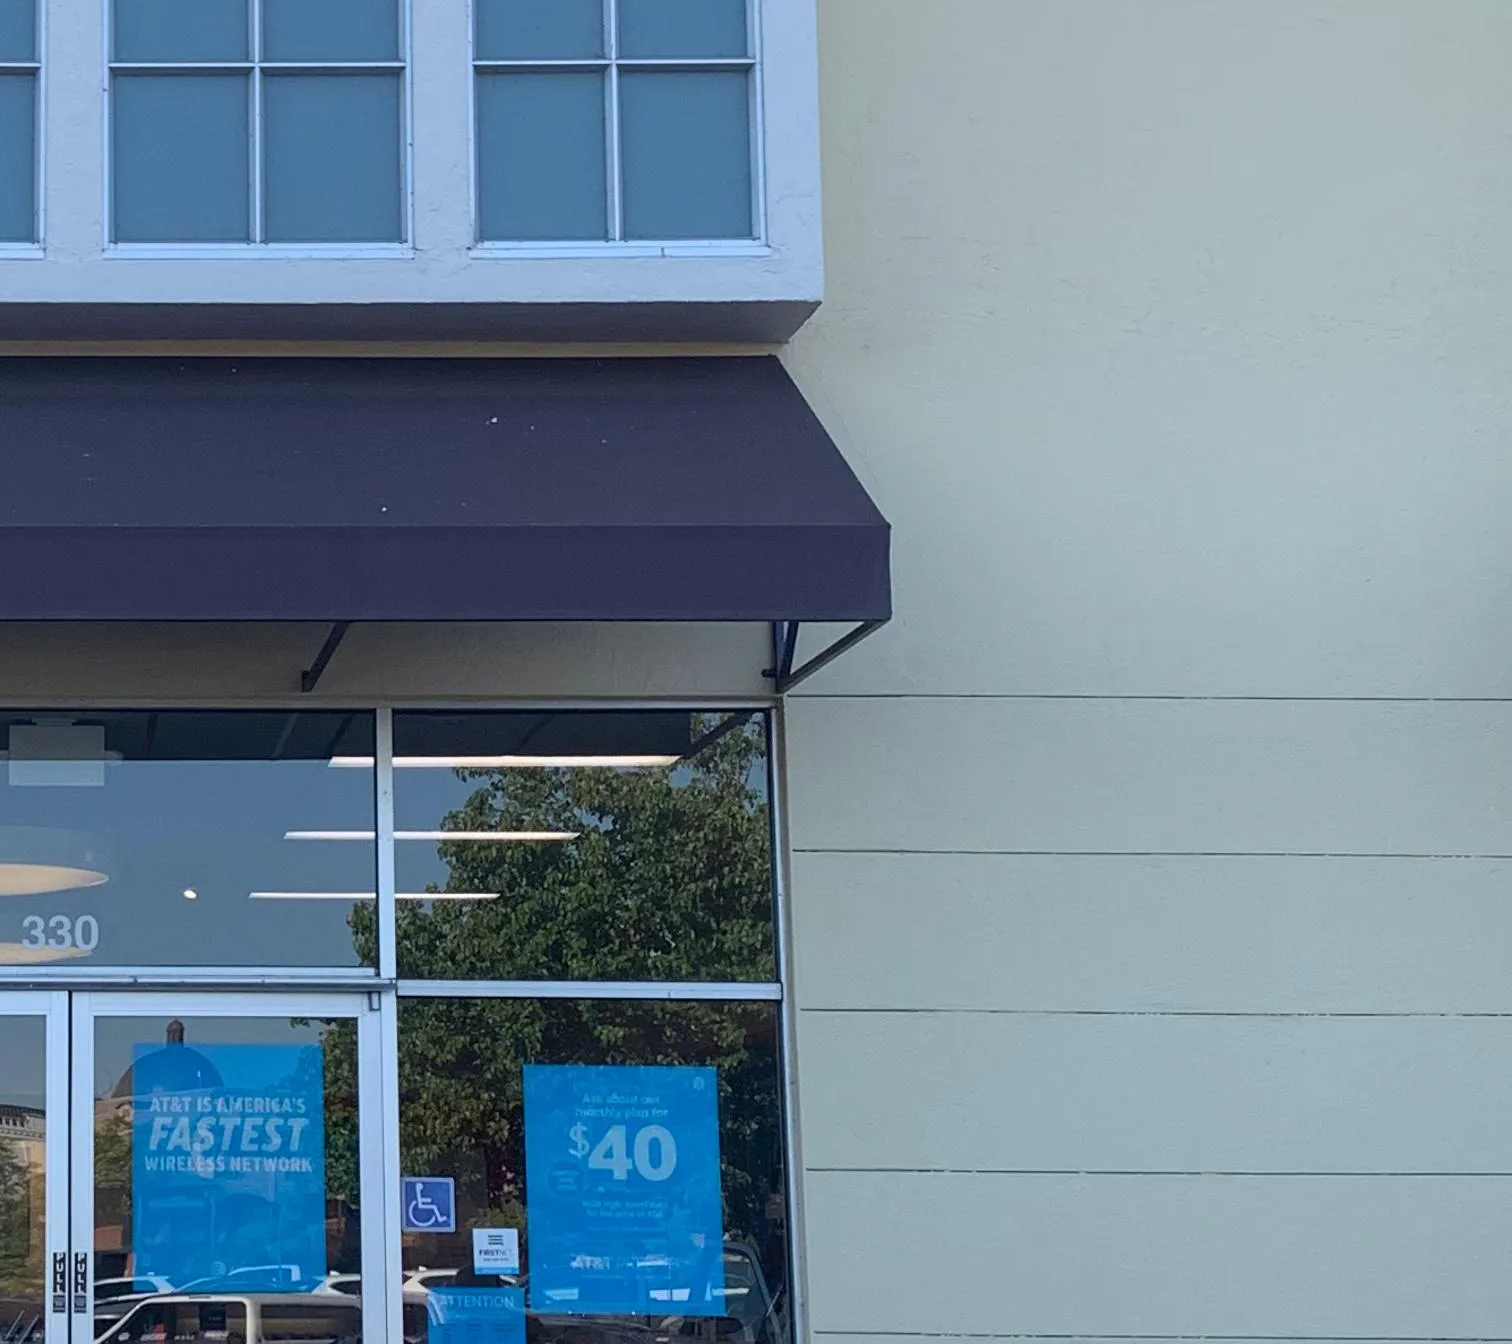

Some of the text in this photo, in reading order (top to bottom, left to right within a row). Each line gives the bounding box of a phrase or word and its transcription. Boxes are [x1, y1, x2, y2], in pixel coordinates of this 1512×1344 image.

[22, 915, 99, 951] 330
[150, 1096, 307, 1113] AT&T IS AMERICA'S
[149, 1117, 309, 1152] FASTEST
[568, 1122, 677, 1181] $40
[144, 1156, 313, 1172] WIRELESS NETWORK
[55, 1252, 65, 1295] PULL
[76, 1252, 86, 1295] PULL
